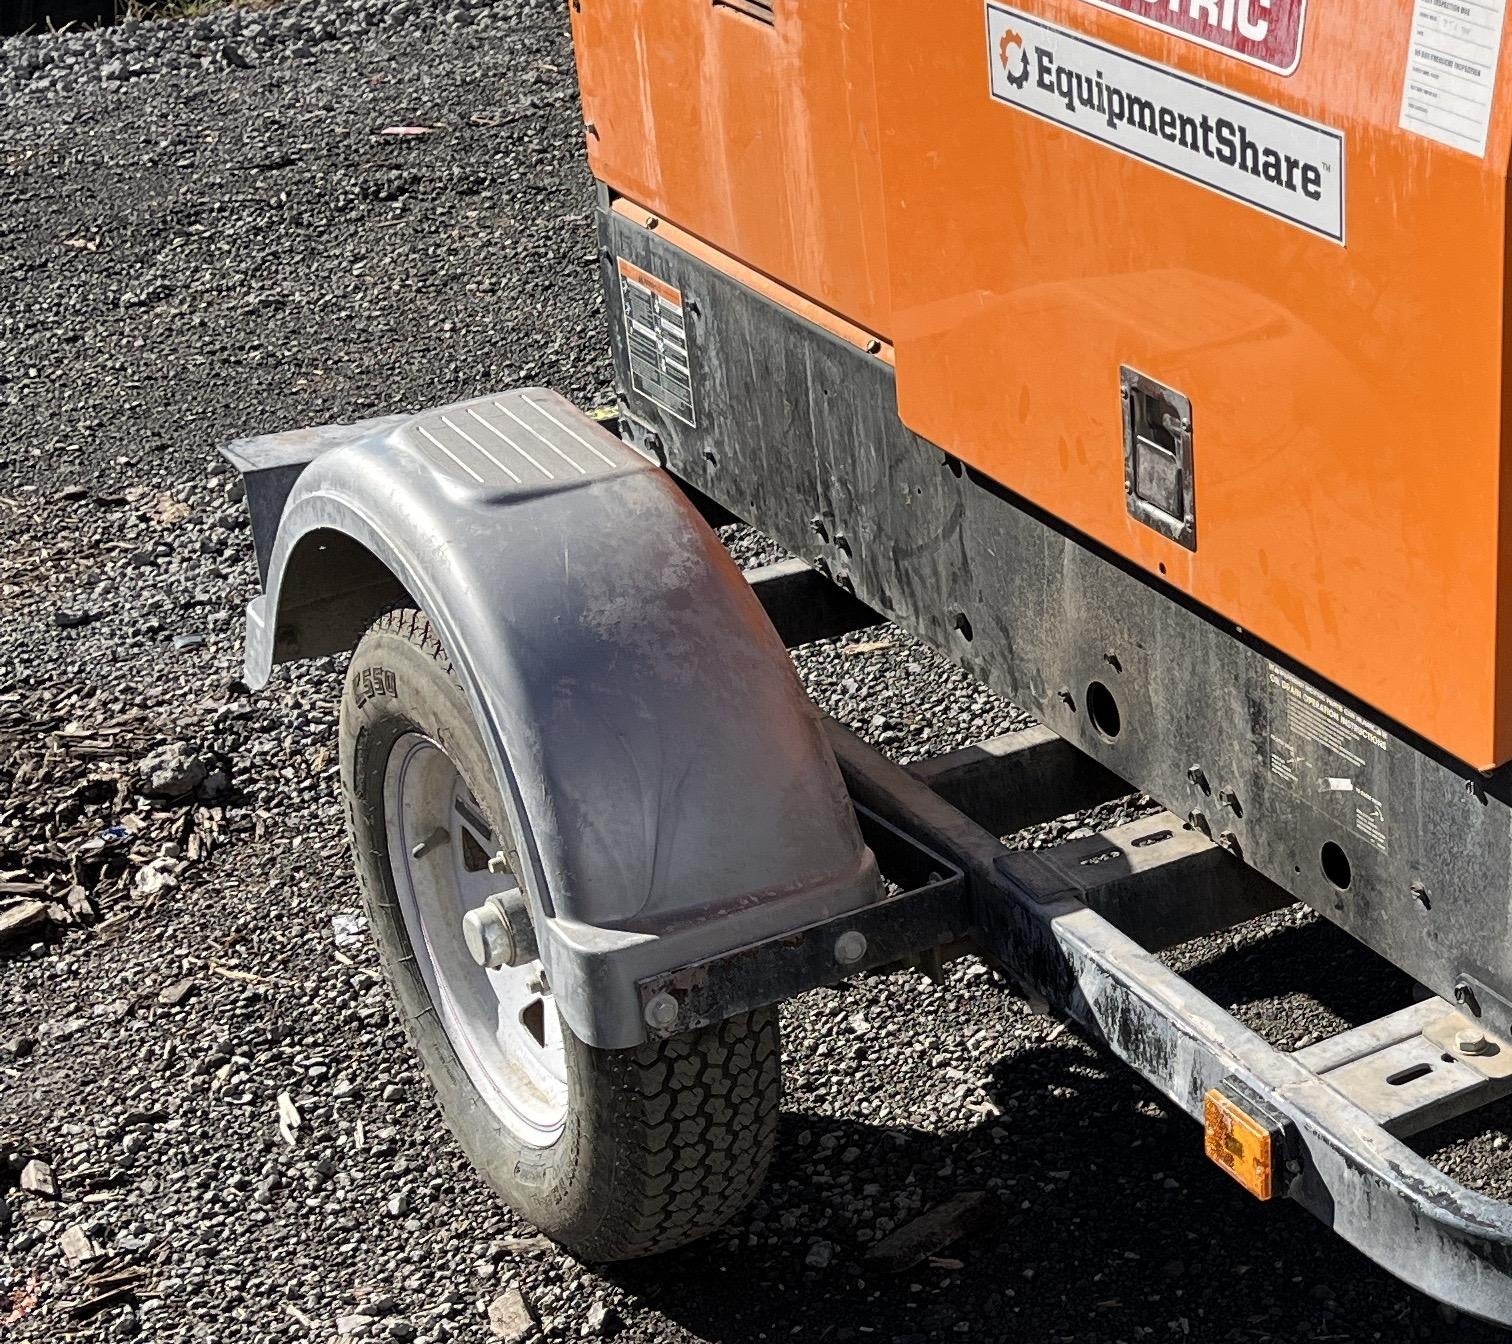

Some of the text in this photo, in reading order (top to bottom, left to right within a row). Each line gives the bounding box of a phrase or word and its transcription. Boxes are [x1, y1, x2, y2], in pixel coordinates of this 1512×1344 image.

[1034, 45, 1323, 202] EquipmentShare
[1302, 693, 1340, 722] OPERATION
[1340, 715, 1387, 751] INSTRUCTIONS
